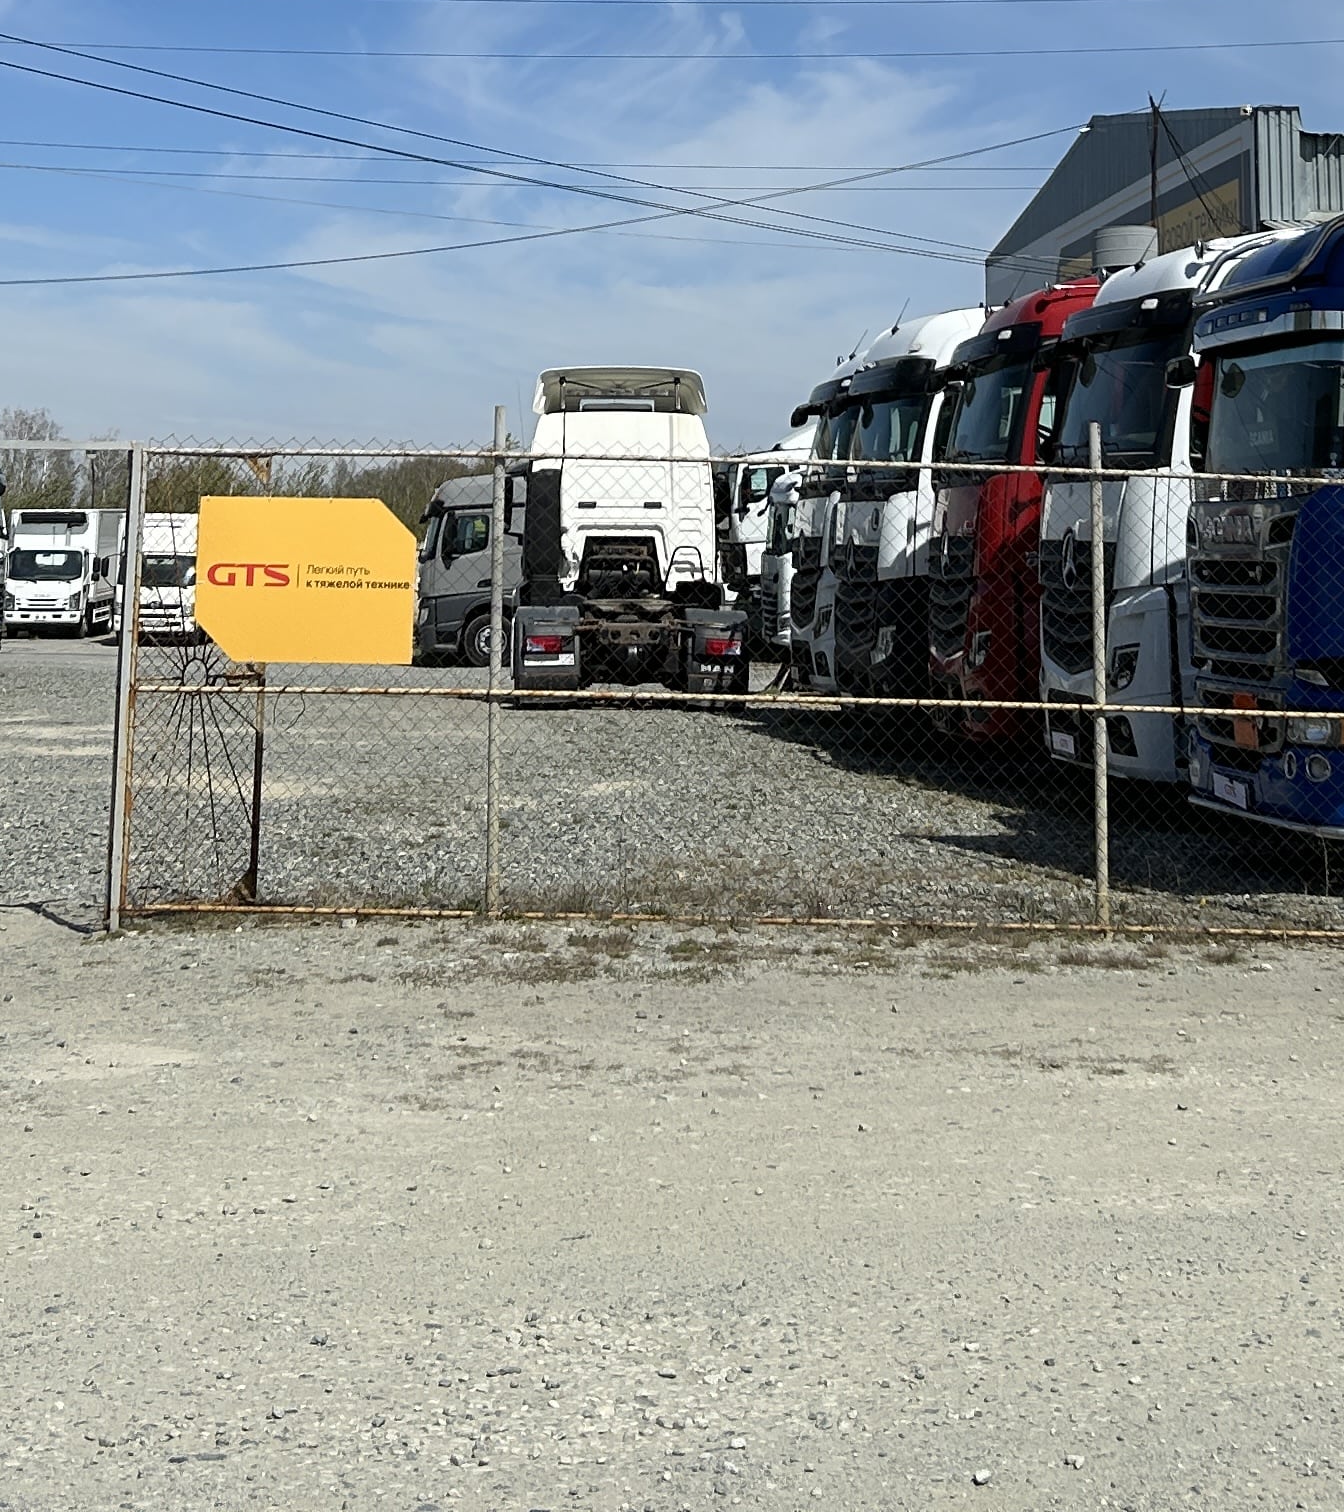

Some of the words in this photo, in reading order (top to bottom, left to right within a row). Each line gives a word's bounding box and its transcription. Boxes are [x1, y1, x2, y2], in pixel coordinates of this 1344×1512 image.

[207, 563, 291, 587] GTS
[306, 564, 345, 576] Легкий
[345, 566, 371, 577] путь
[306, 580, 313, 588] к
[313, 578, 363, 589] тяжелой
[365, 580, 411, 590] технике
[700, 663, 735, 674] MAN
